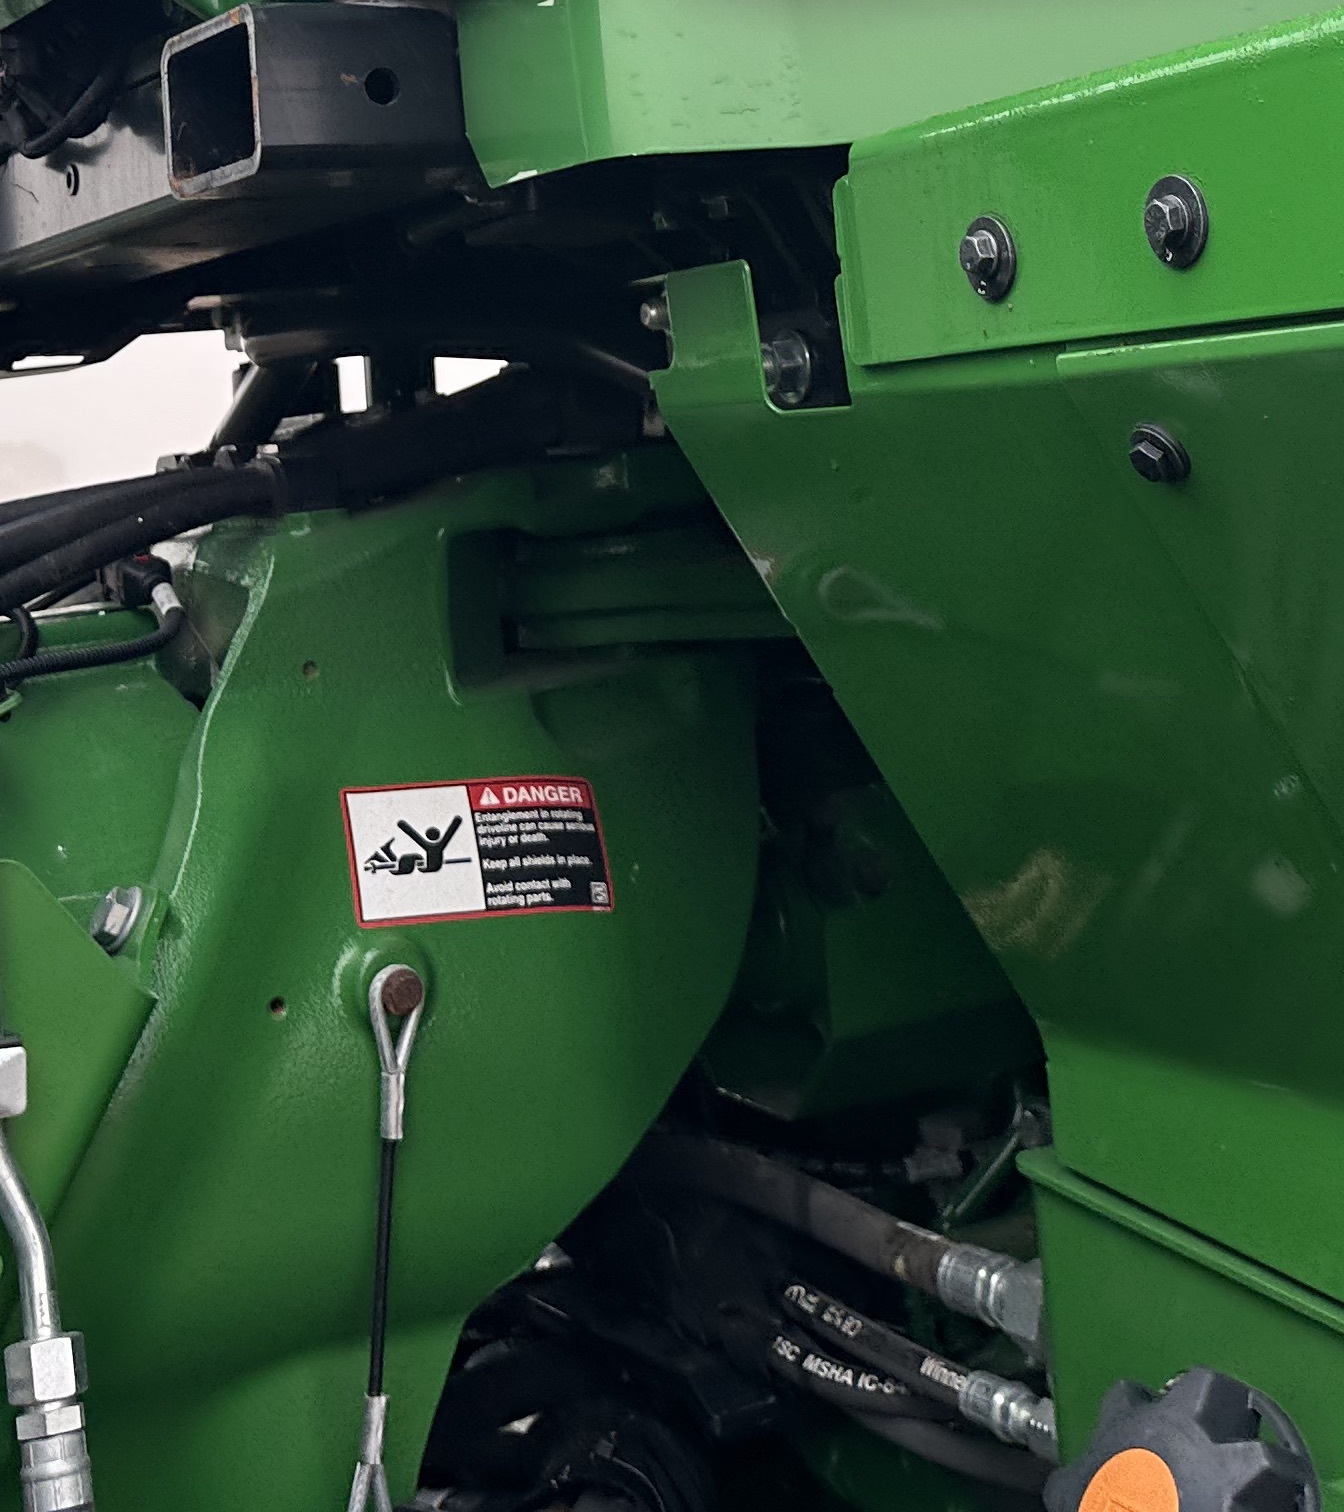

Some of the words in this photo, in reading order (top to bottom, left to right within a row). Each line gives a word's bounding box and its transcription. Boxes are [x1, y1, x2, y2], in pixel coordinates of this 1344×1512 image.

[504, 786, 583, 804] DANGER
[519, 823, 536, 832] can
[479, 835, 506, 847] injury
[509, 836, 518, 844] or
[483, 858, 507, 870] Keep
[509, 856, 521, 867] all
[487, 881, 513, 893] Avoid
[515, 879, 550, 891] contact
[487, 894, 524, 907] rotating
[802, 1353, 854, 1386] MSHA
